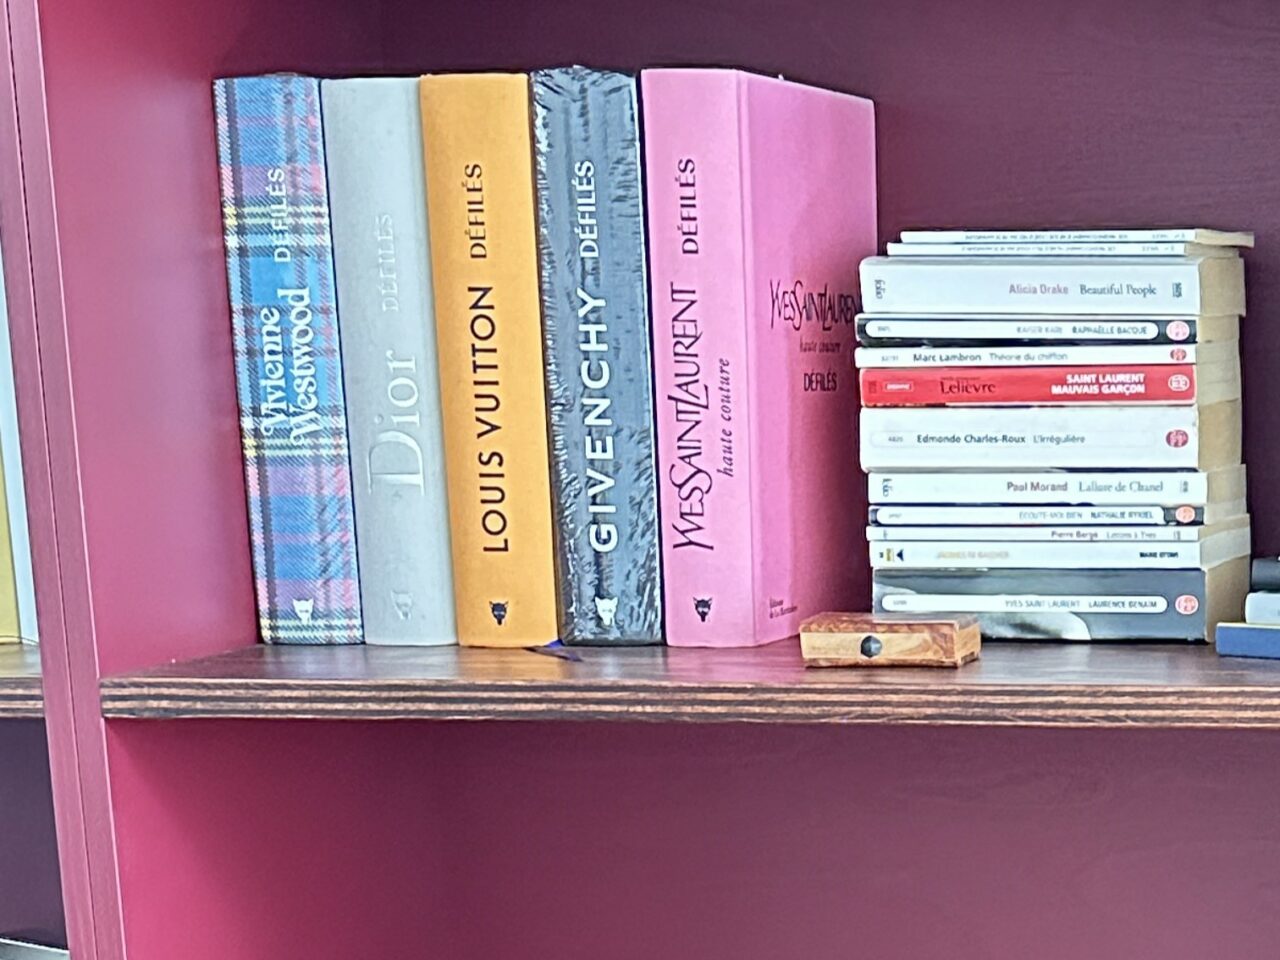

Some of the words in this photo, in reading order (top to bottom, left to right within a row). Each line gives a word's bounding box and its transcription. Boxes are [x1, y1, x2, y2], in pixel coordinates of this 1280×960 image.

[267, 166, 292, 262] DÉFILÉS
[461, 163, 488, 259] DÉFILÉS
[575, 159, 600, 259] DÉFILÉS
[675, 158, 700, 255] DÉFILÉS
[1009, 283, 1038, 295] Alicia
[1040, 283, 1070, 295] Drake
[1079, 283, 1124, 295] Beautiful
[1126, 283, 1158, 299] People
[260, 306, 287, 437] Vivienne
[277, 286, 321, 445] Westwood
[466, 286, 502, 440] VUITTON
[803, 369, 838, 392] DÉFILÉS
[913, 353, 937, 363] Marc
[939, 353, 982, 363] Lambron
[989, 351, 1021, 362] Théorie
[1023, 352, 1036, 362] du
[1066, 374, 1097, 384] SAINT
[1099, 373, 1146, 384] LAURENT
[718, 357, 732, 422] couture
[1051, 384, 1100, 395] MAUVAIS
[1101, 384, 1146, 397] GARÇON
[367, 349, 426, 496] Dior
[577, 287, 619, 552] GIVENCHY
[917, 434, 962, 444] Edmonde
[964, 434, 1026, 444] Charles-Roux
[717, 428, 734, 478] haute
[477, 451, 509, 552] LOUIS
[1007, 481, 1028, 492] Paul
[1030, 481, 1068, 492] Morand
[1115, 481, 1127, 492] de
[1129, 481, 1164, 493] Chanel
[1051, 531, 1074, 539] Pierre
